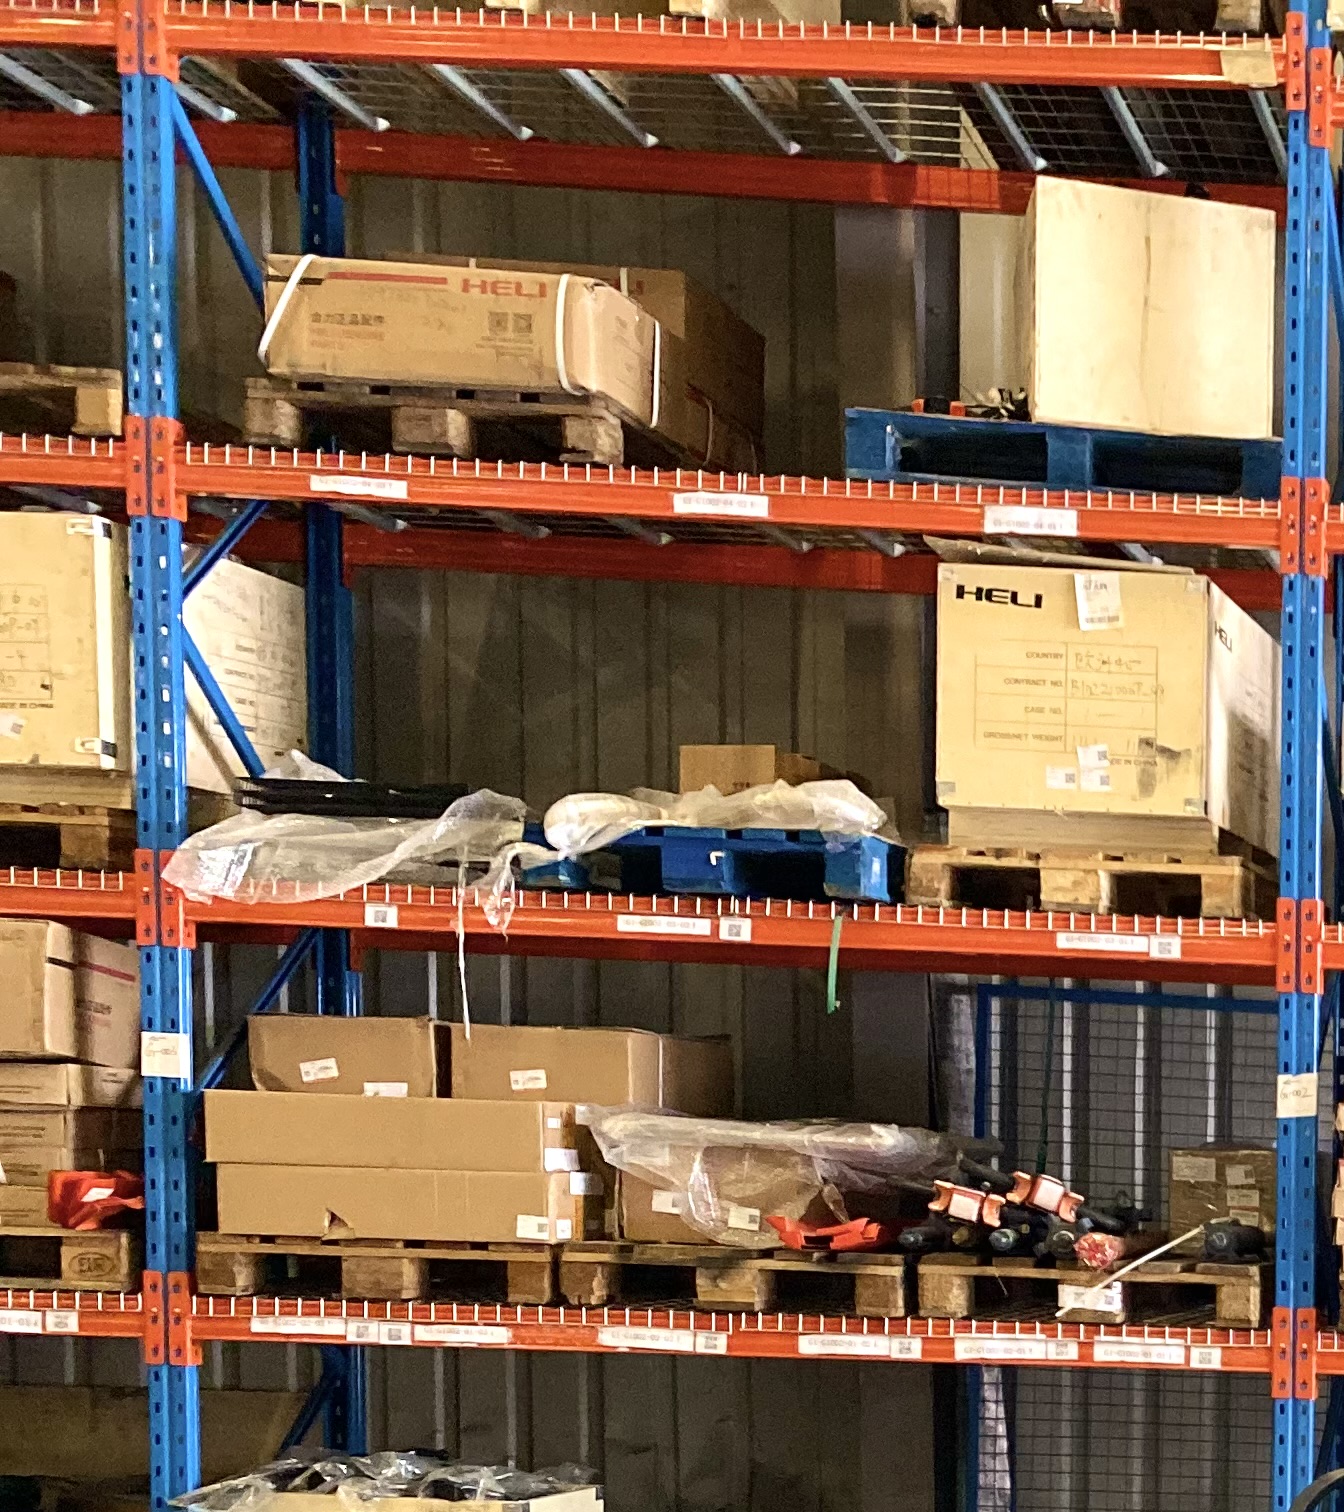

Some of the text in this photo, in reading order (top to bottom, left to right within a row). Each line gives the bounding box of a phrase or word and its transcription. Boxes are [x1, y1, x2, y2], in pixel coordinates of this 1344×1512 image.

[461, 278, 547, 298] HELI
[955, 583, 1044, 610] HELI
[1214, 620, 1233, 653] HELI
[1025, 651, 1064, 661] COUNTRY
